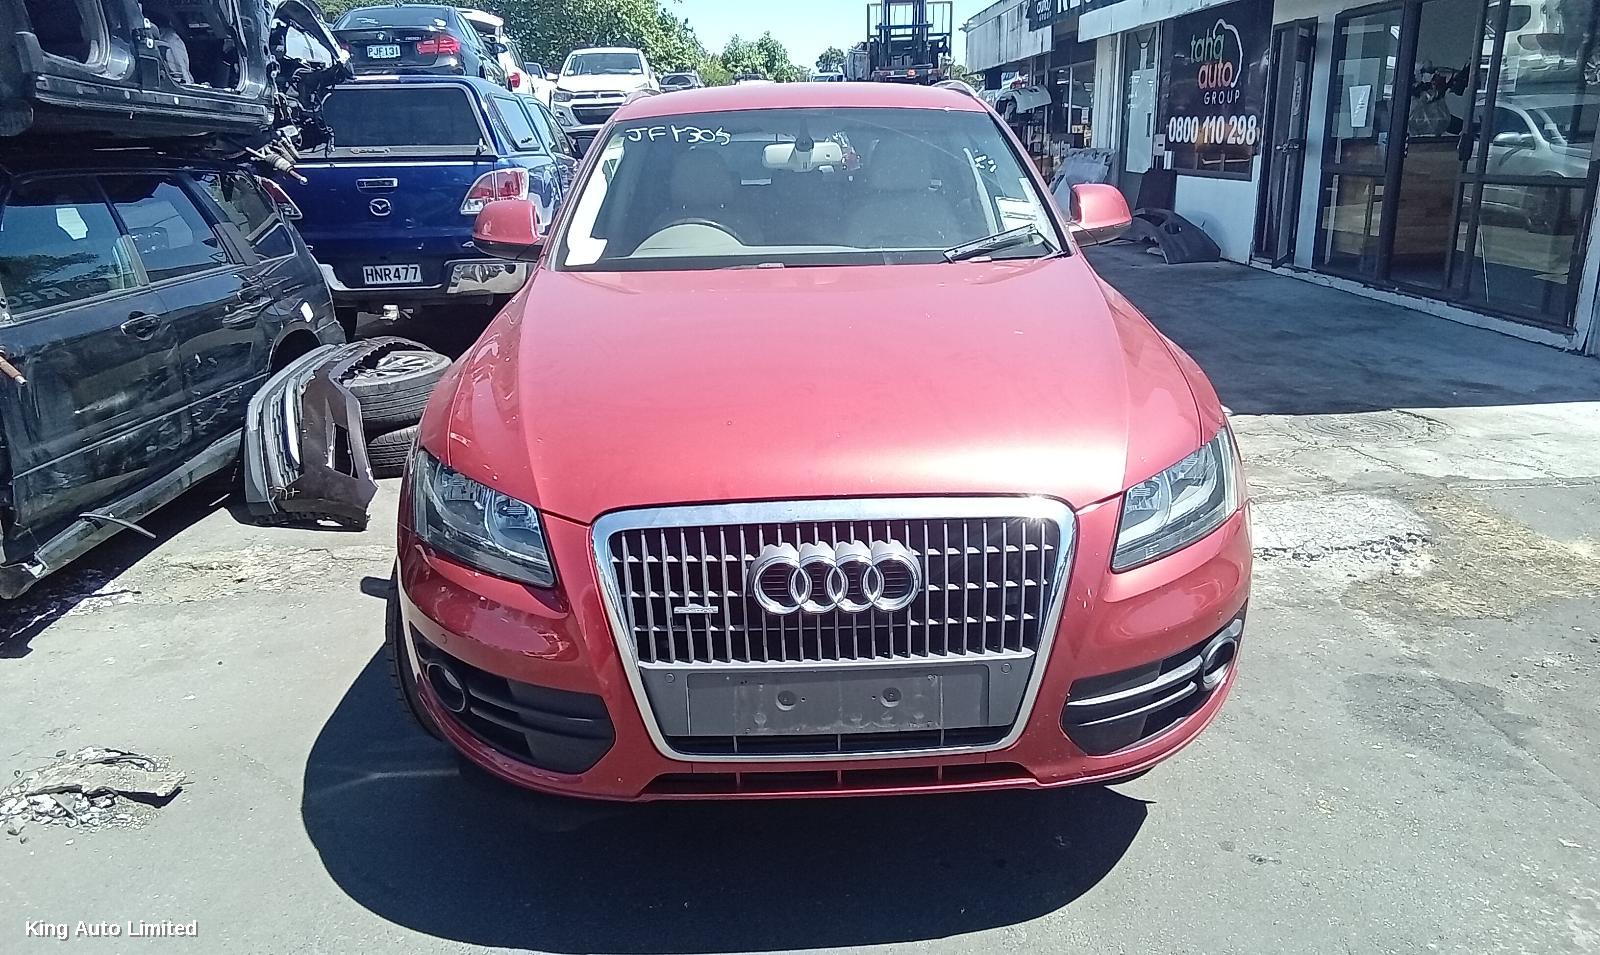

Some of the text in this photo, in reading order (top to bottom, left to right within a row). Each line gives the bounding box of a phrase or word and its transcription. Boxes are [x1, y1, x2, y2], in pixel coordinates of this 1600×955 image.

[368, 46, 399, 57] PJF131
[1198, 60, 1233, 89] auto
[1203, 89, 1240, 105] GROUP
[1168, 114, 1257, 145] 0800 110 298
[365, 265, 419, 283] HNR477
